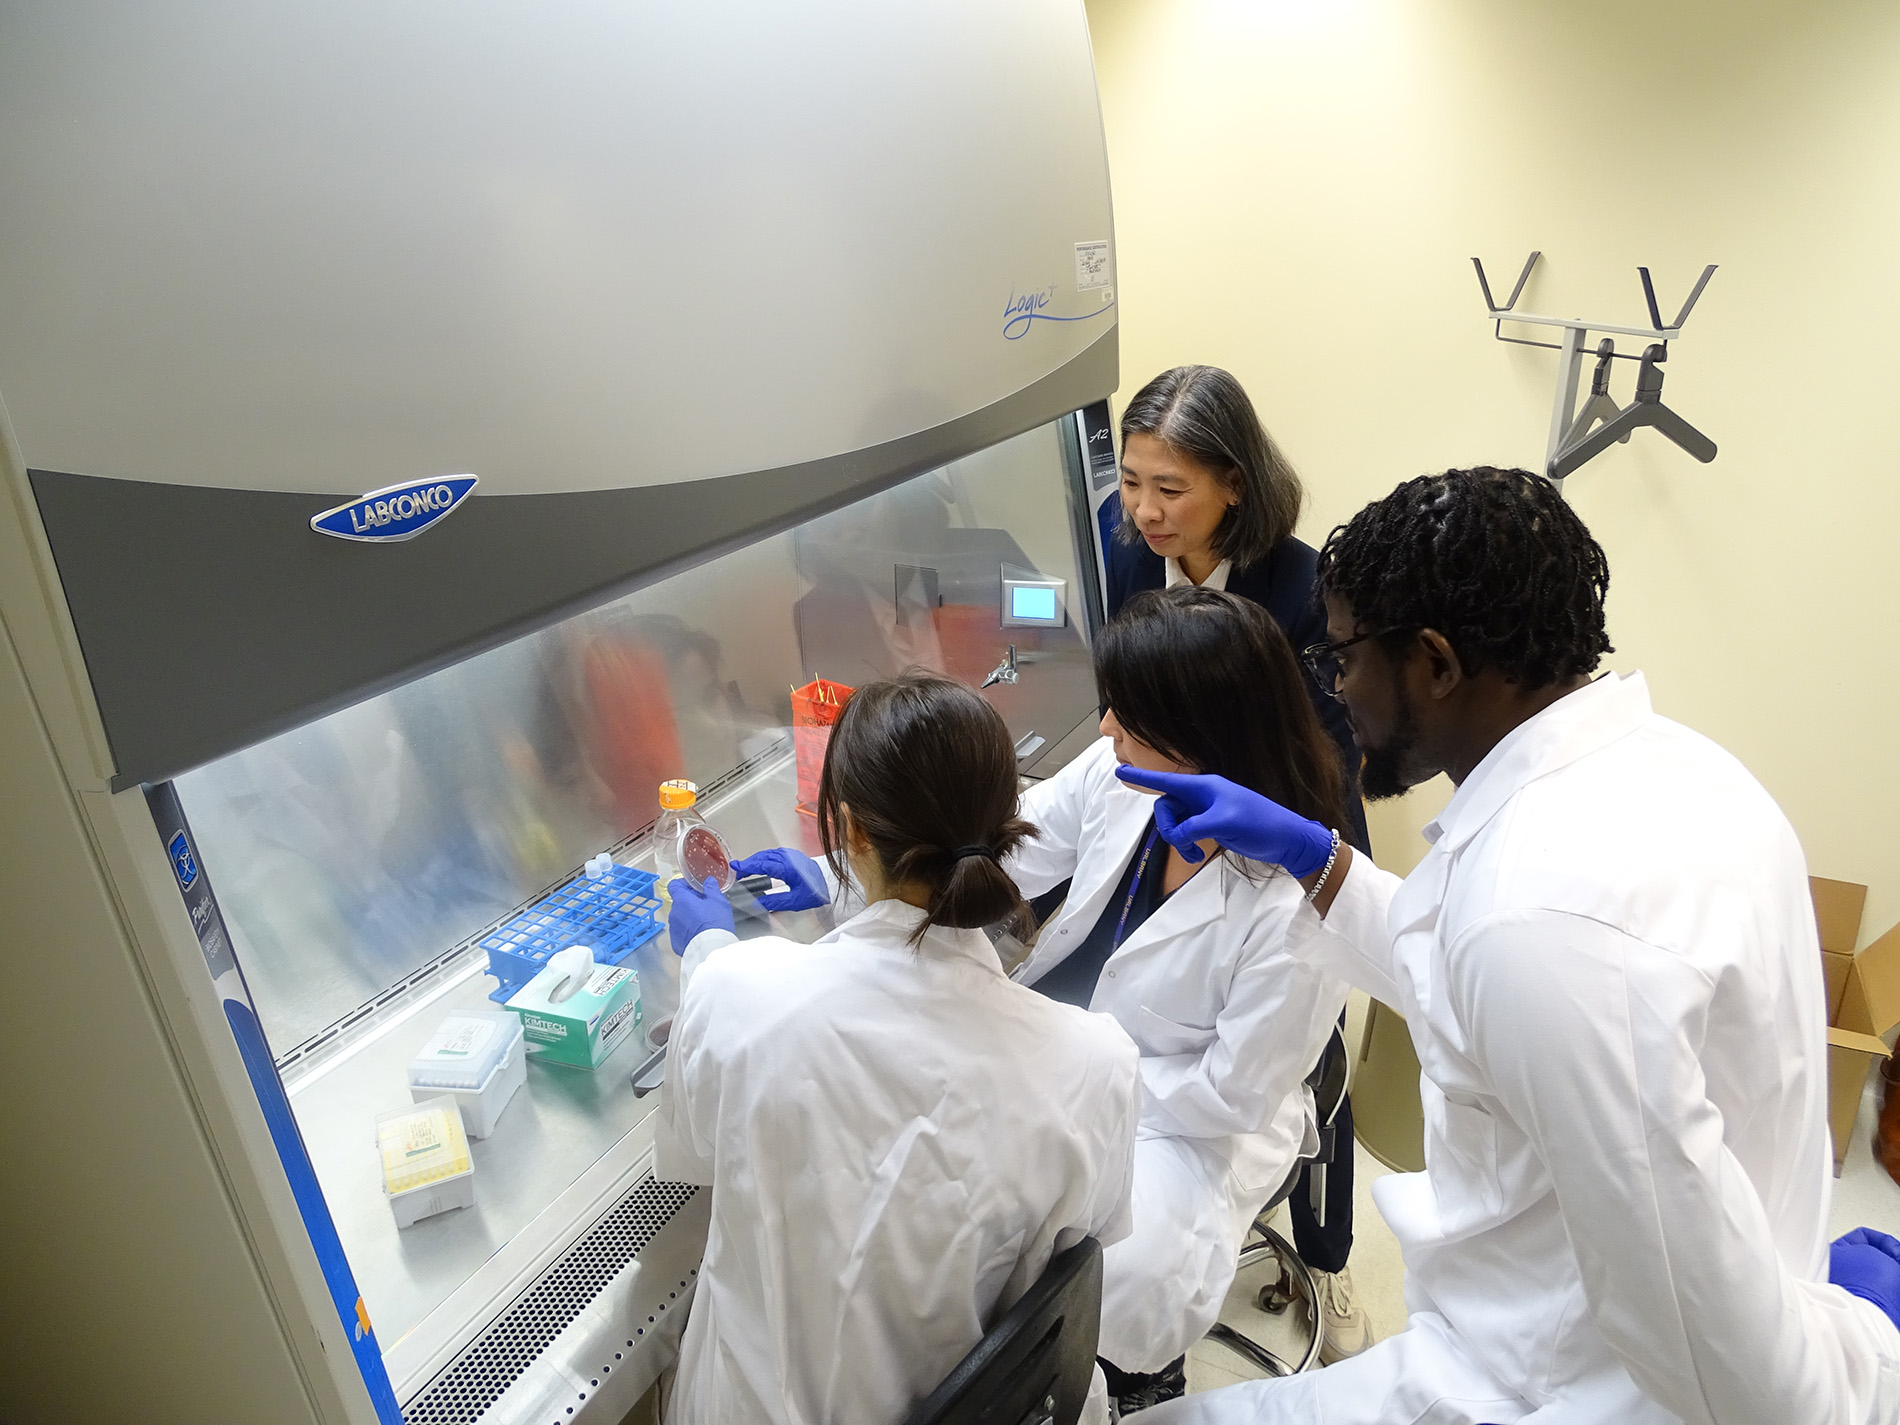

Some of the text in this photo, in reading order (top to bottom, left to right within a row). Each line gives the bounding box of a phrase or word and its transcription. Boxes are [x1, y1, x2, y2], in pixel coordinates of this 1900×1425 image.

[1089, 428, 1109, 443] A2
[349, 484, 453, 533] LABCONCO
[524, 1016, 567, 1033] KIMTECH
[601, 999, 634, 1037] KIMTECH
